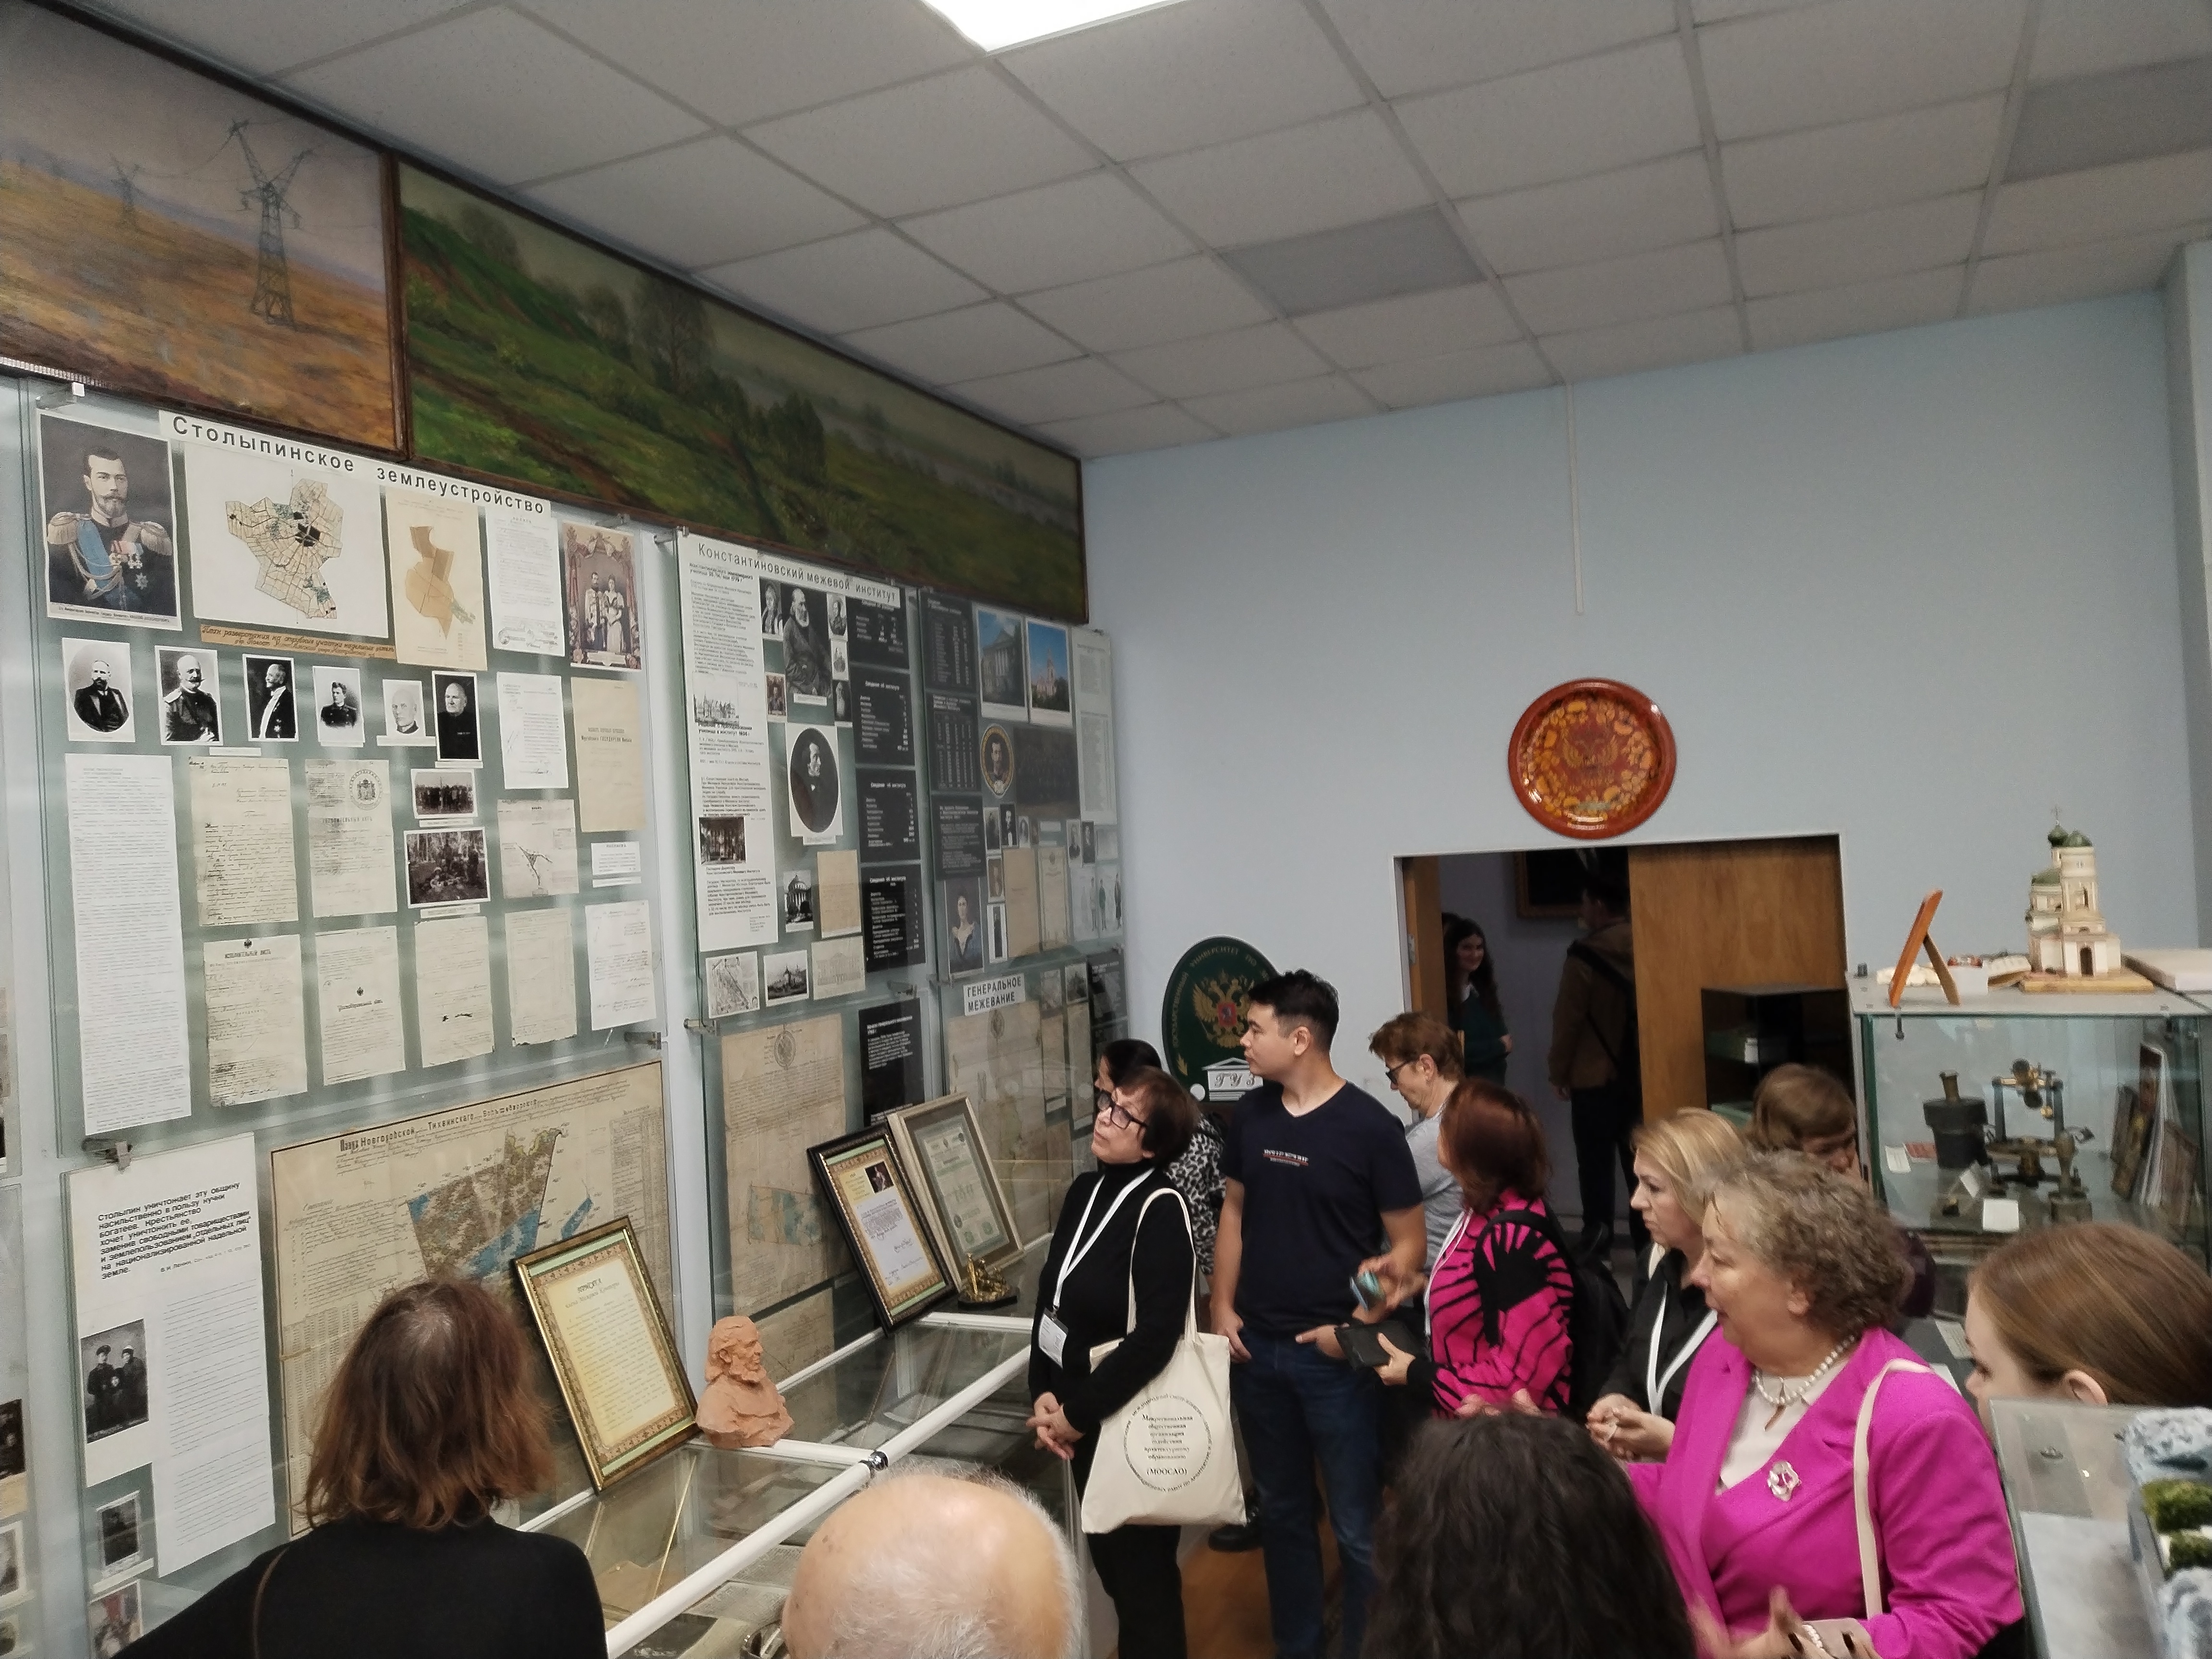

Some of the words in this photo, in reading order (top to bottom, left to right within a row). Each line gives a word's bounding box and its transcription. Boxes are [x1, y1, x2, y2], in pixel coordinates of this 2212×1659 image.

[173, 416, 354, 471] Столыпинское
[377, 468, 543, 513] землеустройство
[698, 542, 804, 580] Константиновский
[807, 571, 850, 589] межевой
[855, 583, 896, 602] институт
[967, 976, 1021, 997] ГЕНЕРАЛЬНОЕ
[968, 991, 1015, 1012] МЕЖЕВАНИЕ
[98, 1206, 141, 1221] Столыпин
[144, 1194, 191, 1212] уничтожает
[211, 1182, 240, 1194] общину
[99, 1209, 162, 1229] насильственно
[172, 1201, 199, 1211] пользу
[100, 1240, 136, 1254] заменив
[139, 1227, 189, 1244] свободными
[191, 1210, 250, 1230] товариществами
[100, 1235, 124, 1246] хочет
[128, 1222, 177, 1240] уничтожить
[109, 1234, 192, 1261] землепользованием
[115, 1236, 205, 1267] национализированной
[207, 1226, 247, 1241] надельной
[1142, 1414, 1193, 1423] Межрегиональная
[1147, 1467, 1187, 1476] (МООСАО)
